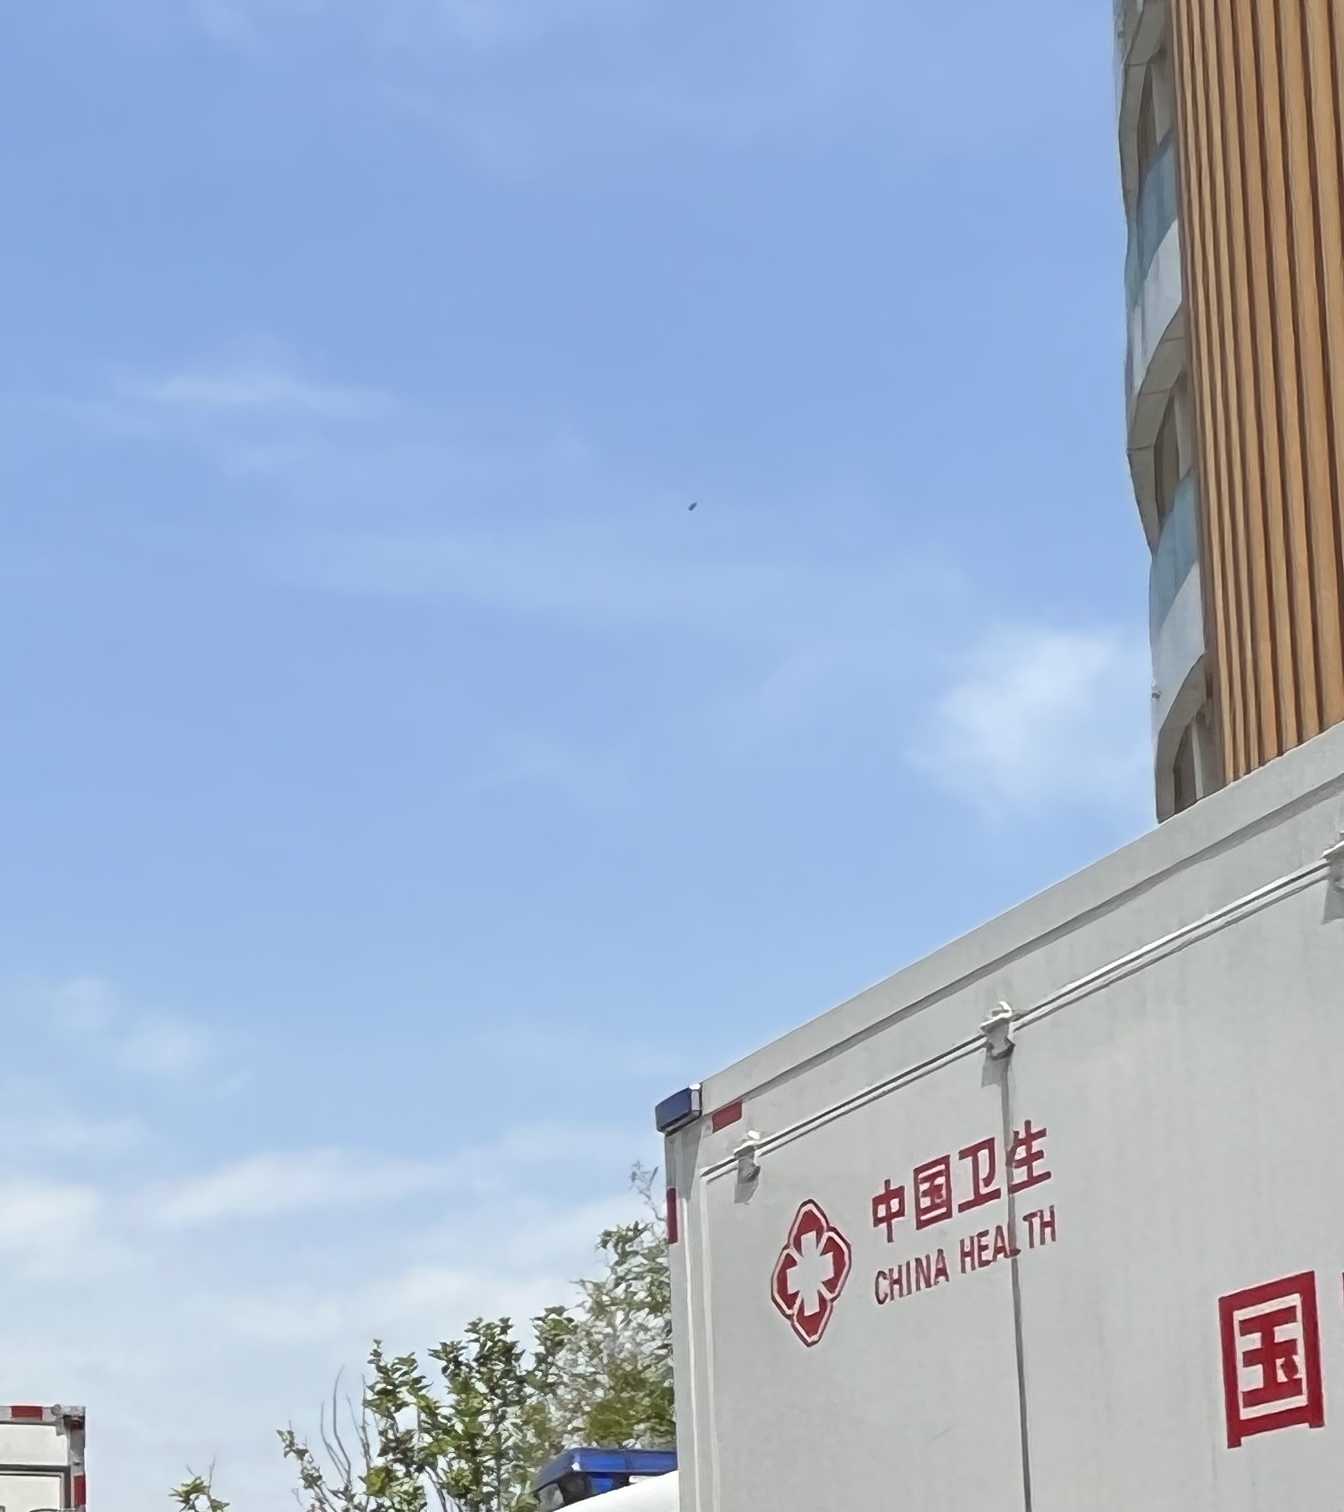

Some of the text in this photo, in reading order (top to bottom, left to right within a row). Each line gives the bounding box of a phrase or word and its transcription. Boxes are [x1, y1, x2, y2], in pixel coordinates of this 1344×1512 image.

[871, 1119, 1052, 1243] 中国卫生
[874, 1205, 1057, 1305] CHINA HEALTH
